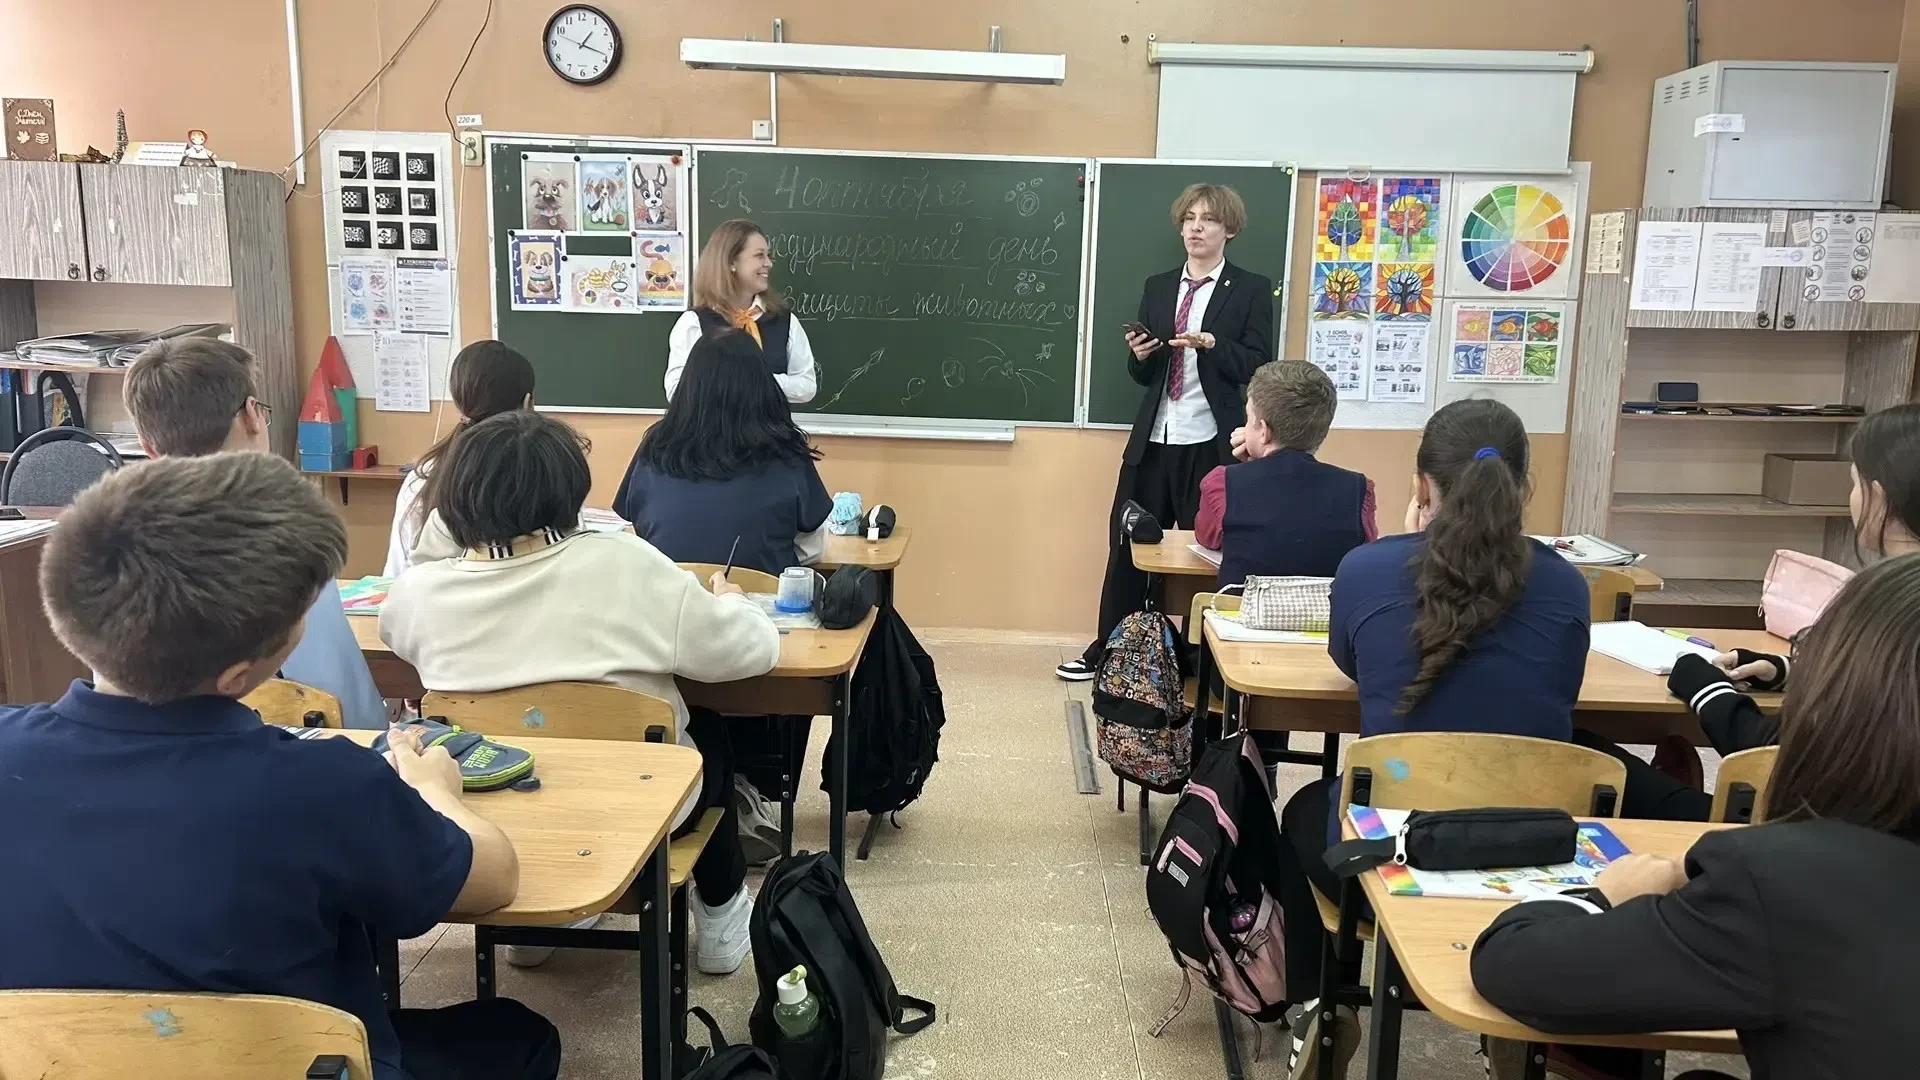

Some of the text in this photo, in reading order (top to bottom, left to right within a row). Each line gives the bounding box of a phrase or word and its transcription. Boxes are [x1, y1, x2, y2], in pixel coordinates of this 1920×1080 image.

[565, 16, 573, 25] 11
[577, 12, 586, 21] 12
[593, 16, 597, 25] 1
[556, 26, 565, 35] 10
[603, 28, 608, 36] 2
[551, 40, 557, 48] 9
[608, 42, 613, 50] 3
[555, 53, 561, 62] 8
[602, 55, 608, 64] 4
[567, 64, 572, 72] 7
[593, 66, 599, 74] 5
[580, 69, 586, 77] 6
[775, 165, 799, 209] 4
[987, 236, 1058, 286] день
[913, 284, 1063, 325] животных
